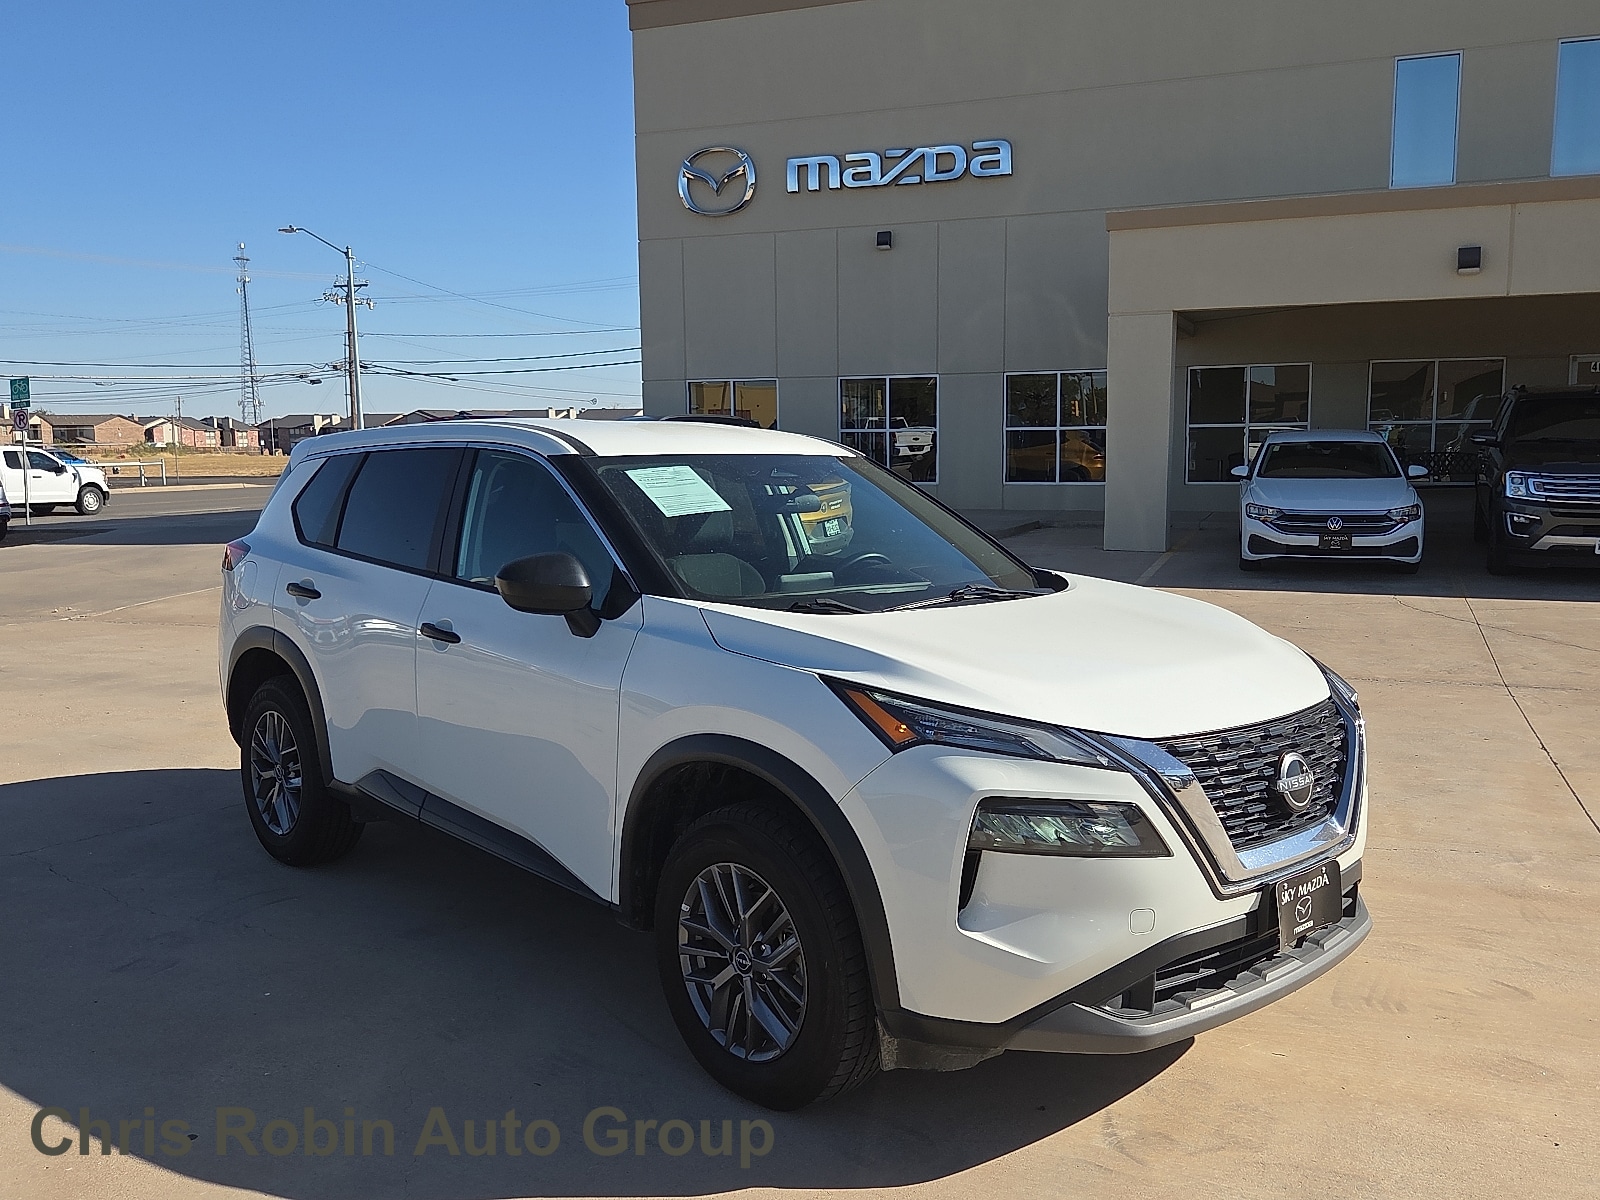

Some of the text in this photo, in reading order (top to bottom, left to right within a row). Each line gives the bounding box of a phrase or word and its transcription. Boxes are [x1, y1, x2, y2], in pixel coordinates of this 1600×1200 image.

[1279, 771, 1314, 791] NISSAN
[1281, 873, 1330, 906] SKY MAZDA
